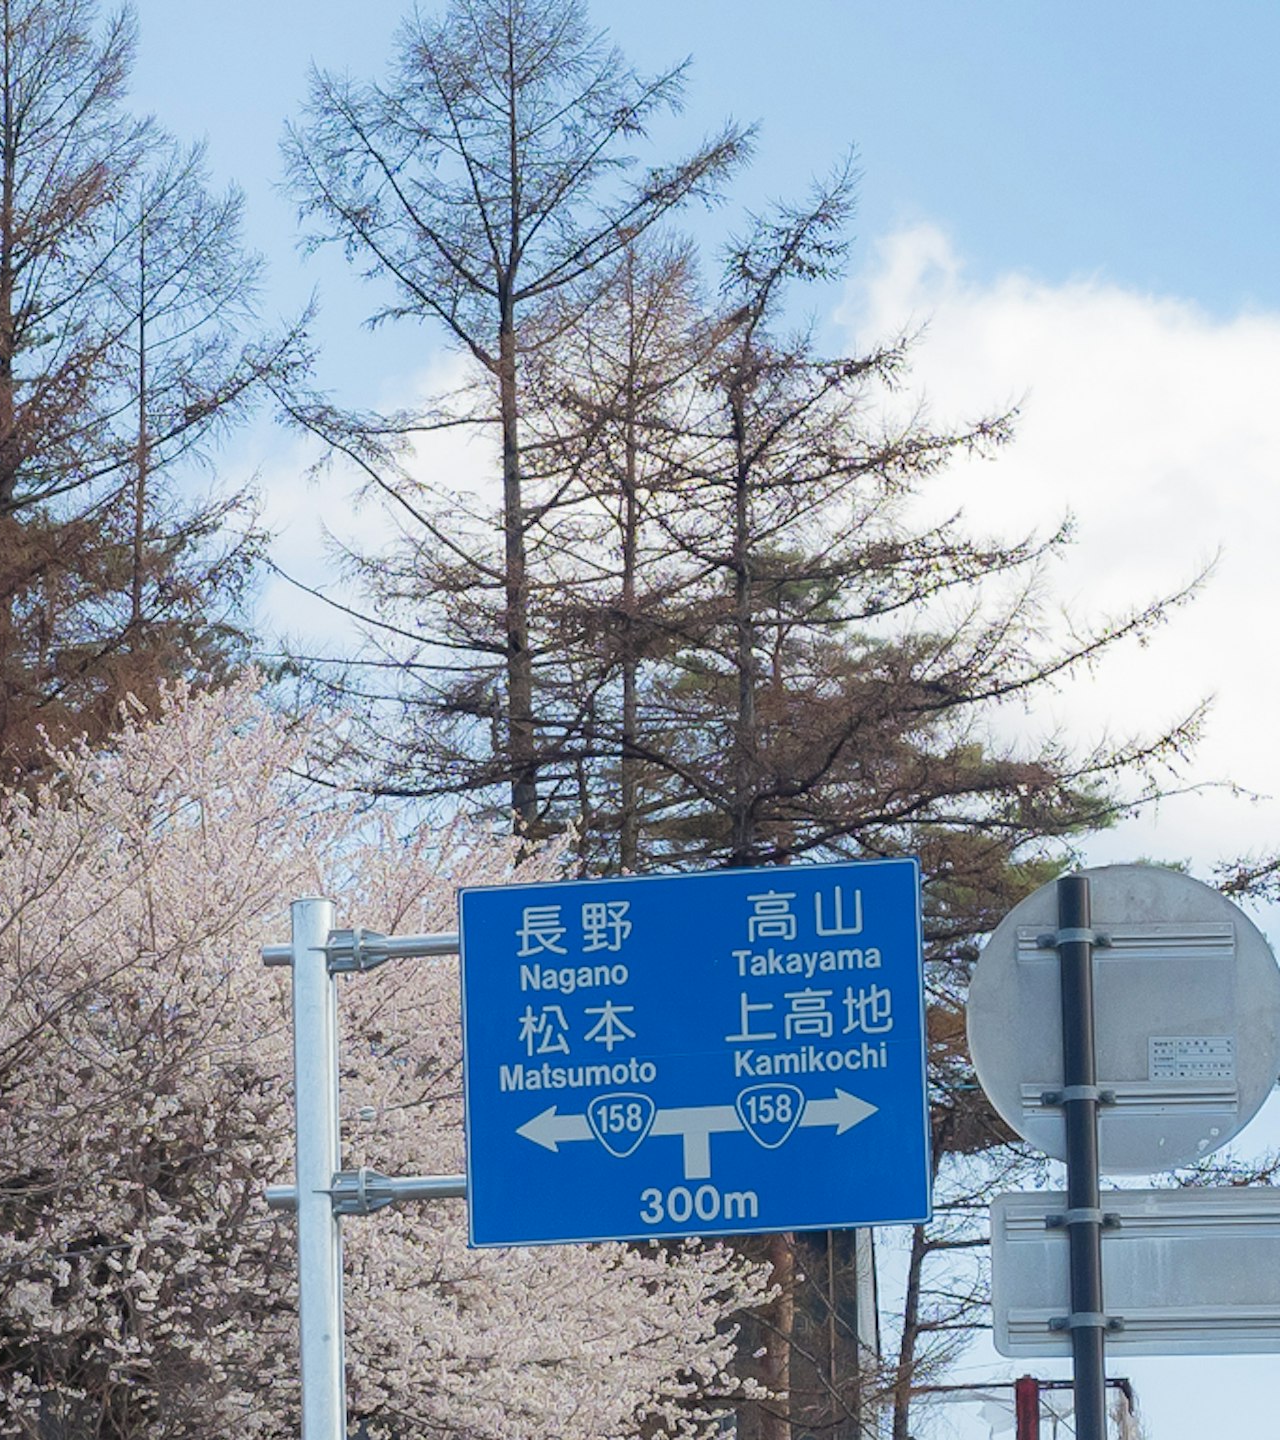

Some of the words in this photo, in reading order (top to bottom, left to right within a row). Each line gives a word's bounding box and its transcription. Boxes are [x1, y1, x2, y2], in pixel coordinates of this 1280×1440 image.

[516, 901, 632, 957] 長野
[747, 886, 863, 942] 高山
[520, 964, 628, 994] Nagano
[732, 948, 881, 978] Takayama
[519, 1000, 636, 1056] 松本
[725, 984, 893, 1042] 上高地
[499, 1058, 657, 1092] Matsumoto
[734, 1043, 887, 1077] Kamikochi
[597, 1104, 642, 1133] 158
[746, 1095, 792, 1124] 158
[640, 1185, 758, 1224] 300m
